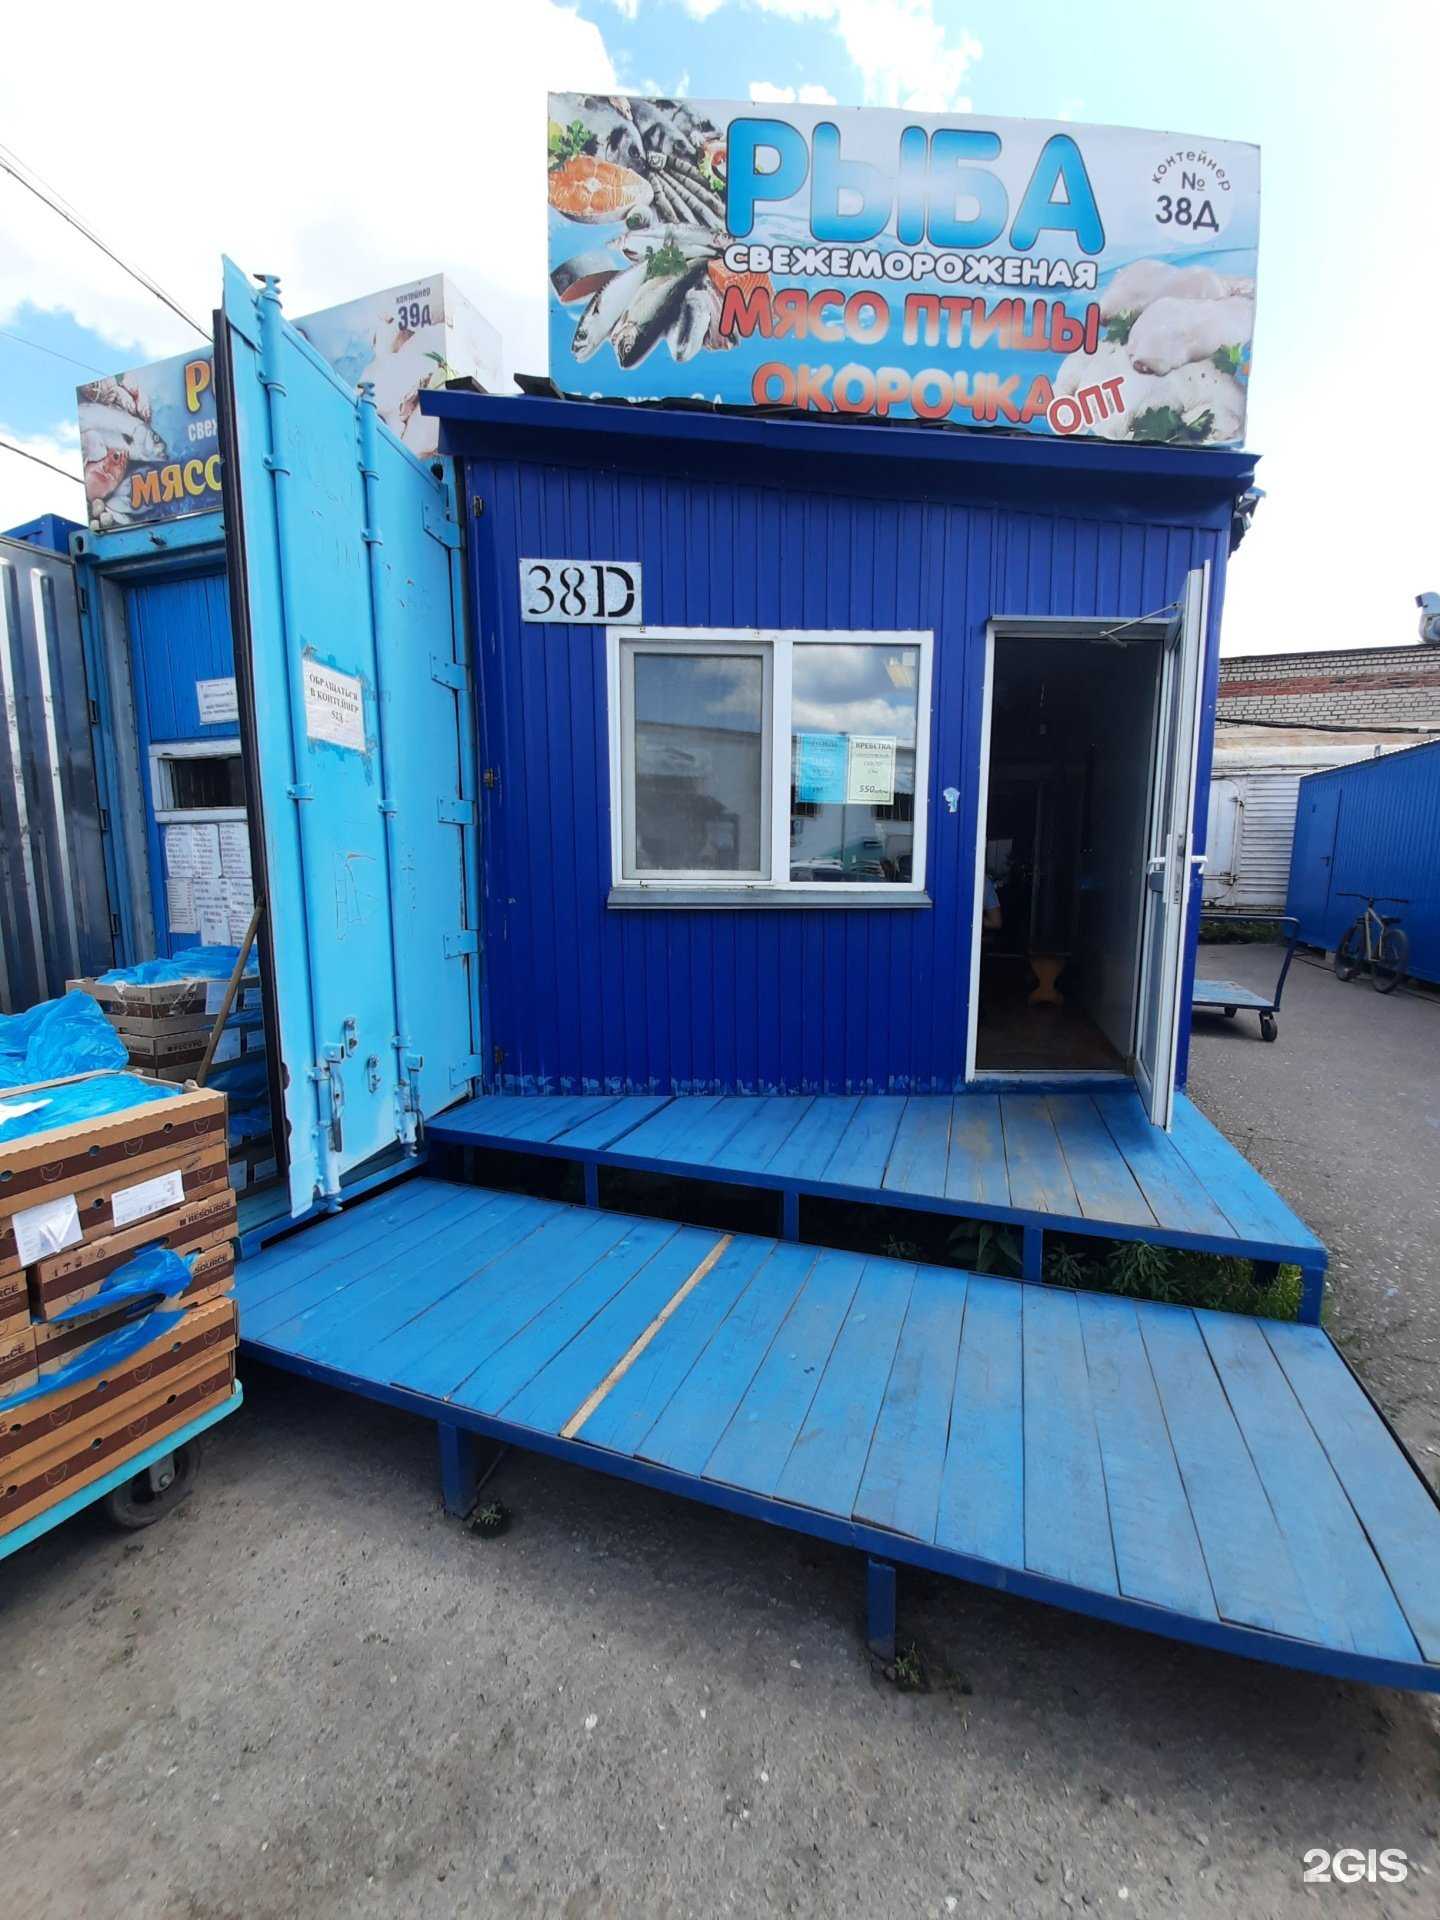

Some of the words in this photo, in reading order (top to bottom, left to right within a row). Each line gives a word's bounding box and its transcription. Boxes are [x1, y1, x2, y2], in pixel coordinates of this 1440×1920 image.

[725, 118, 1105, 255] РЫБА
[1152, 150, 1231, 191] контейнер
[1155, 195, 1219, 232] 38Д
[723, 243, 1098, 290] СВЕЖЕМОРОЖЕНАЯ
[398, 303, 431, 331] 39Д
[718, 285, 890, 346] МЯСО
[902, 293, 1101, 355] ПТИЦЫ
[751, 361, 1056, 423] ОКОРОЧКА
[1046, 375, 1126, 435] ОПТ
[528, 565, 635, 617] 38D
